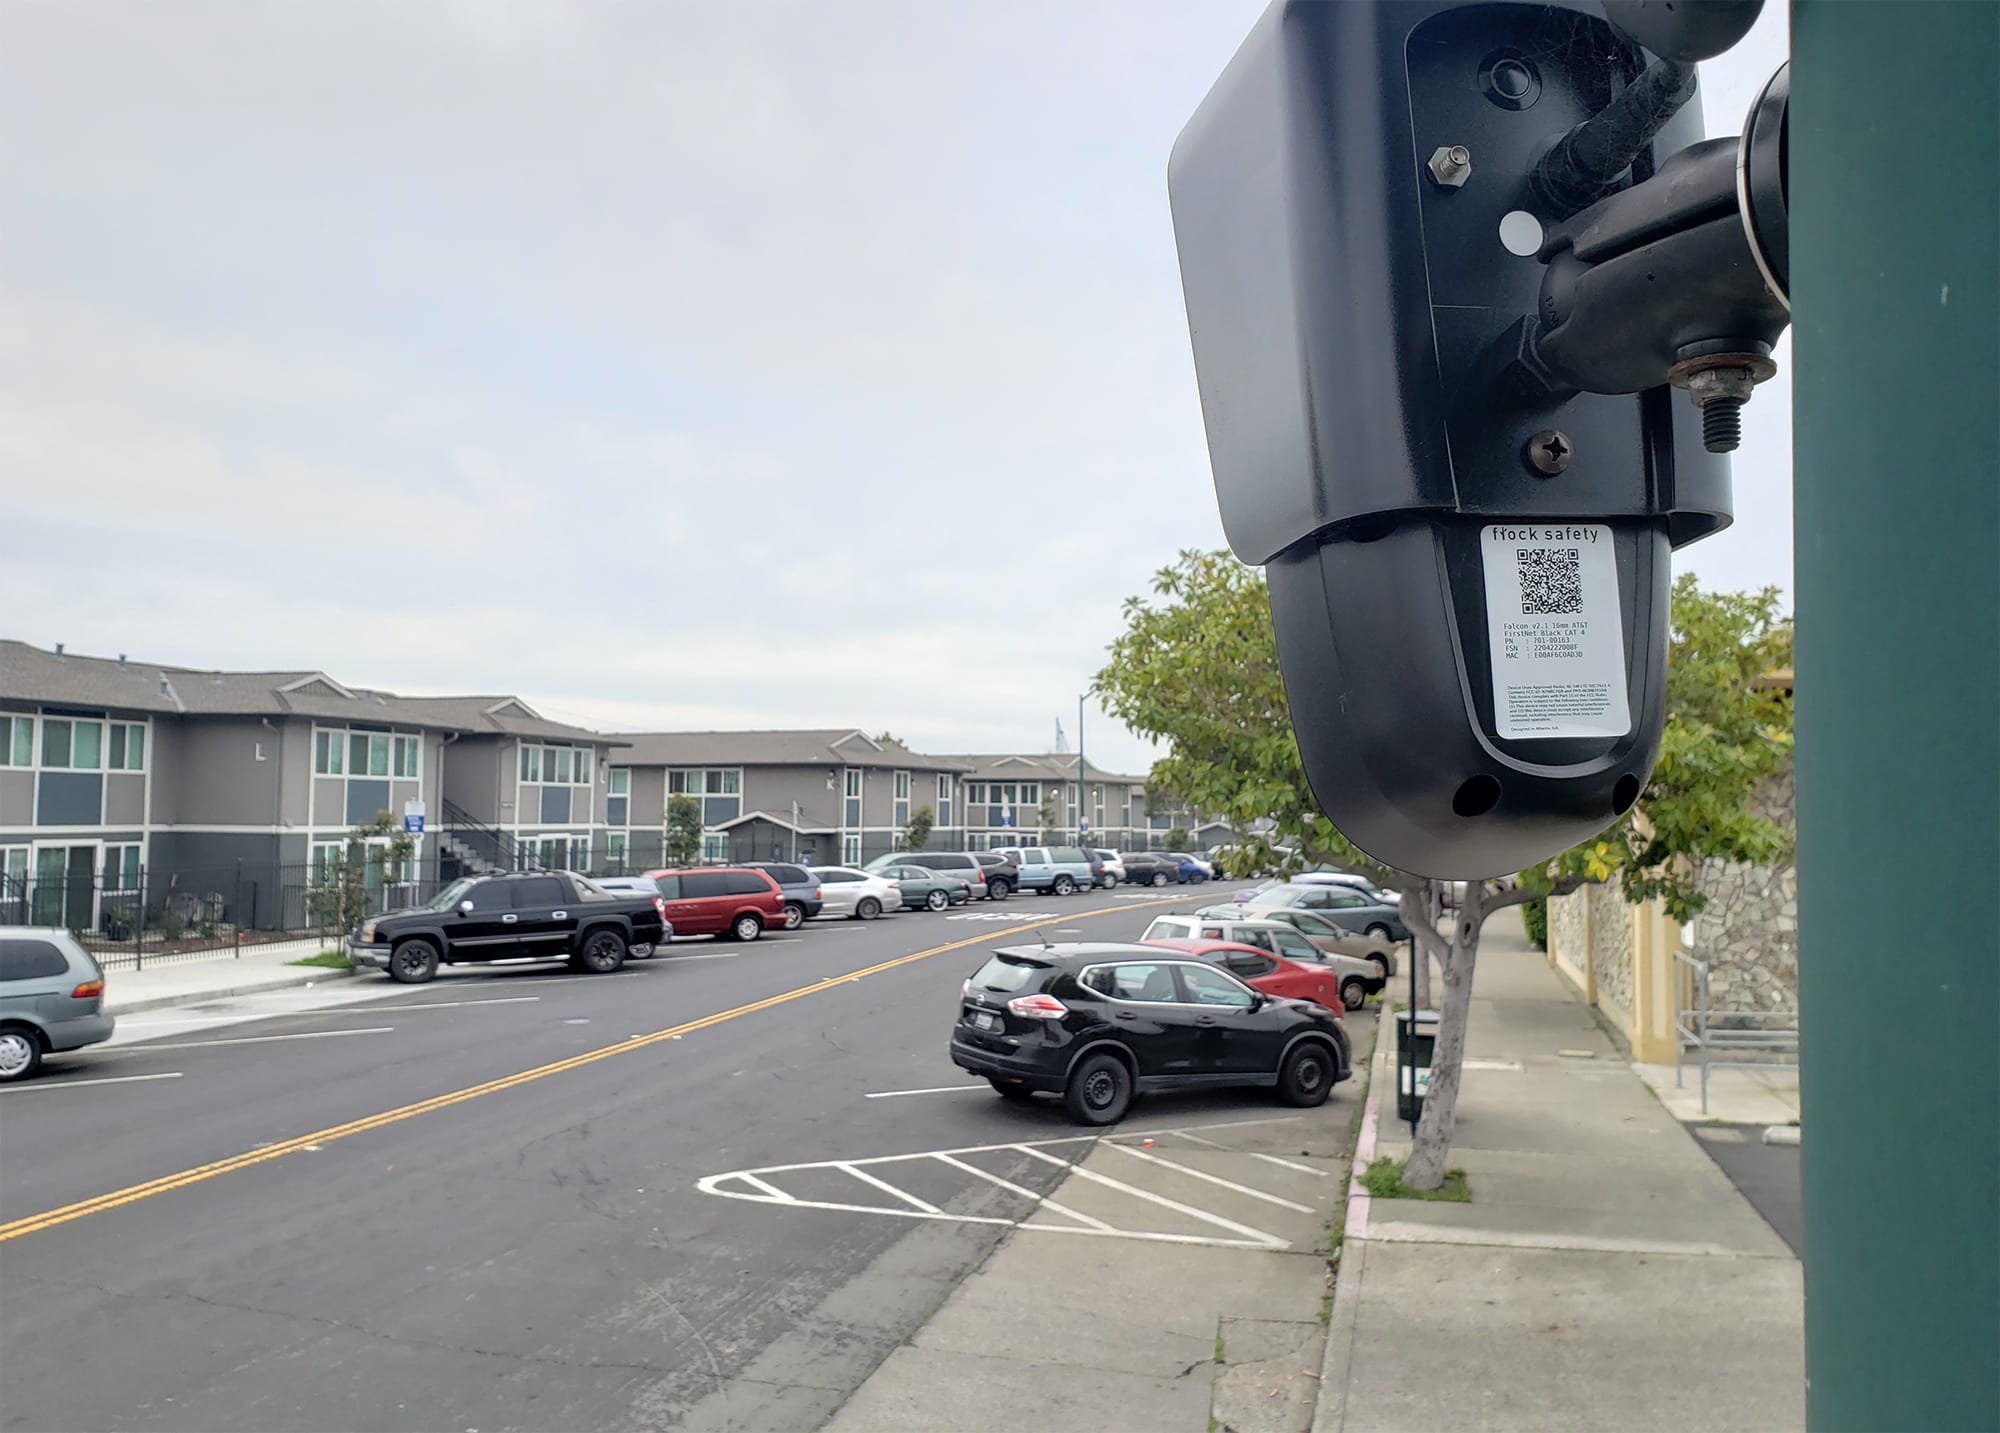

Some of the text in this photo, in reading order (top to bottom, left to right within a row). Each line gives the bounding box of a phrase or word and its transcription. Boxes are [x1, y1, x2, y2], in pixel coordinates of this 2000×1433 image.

[1493, 527, 1598, 543] flock safety
[256, 742, 266, 761] L
